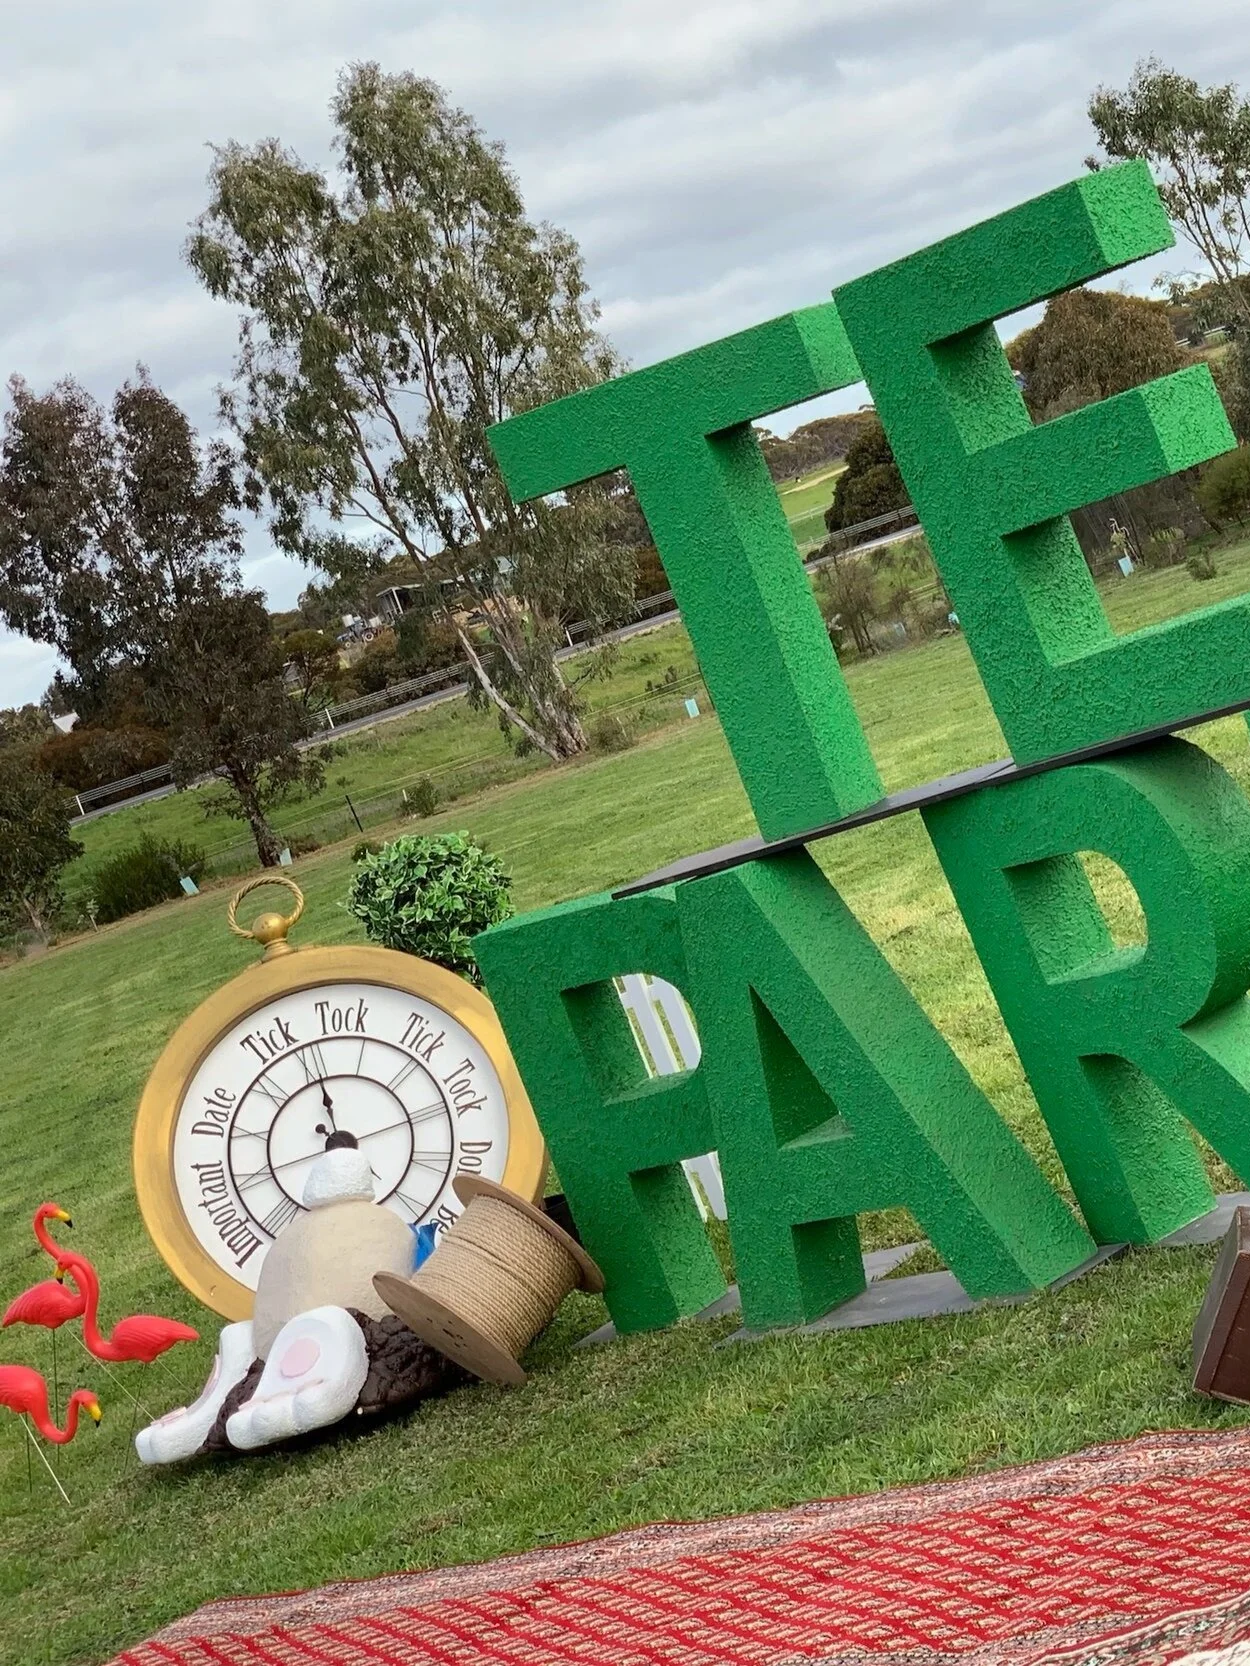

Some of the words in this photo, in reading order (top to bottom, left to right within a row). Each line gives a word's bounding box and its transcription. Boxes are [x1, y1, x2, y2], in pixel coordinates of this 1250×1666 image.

[239, 1017, 300, 1065] Tick
[314, 998, 369, 1036] Tock
[399, 1012, 446, 1063] Tick
[442, 1057, 488, 1118] Tock
[191, 1087, 237, 1138] Date
[190, 1160, 264, 1269] Important
